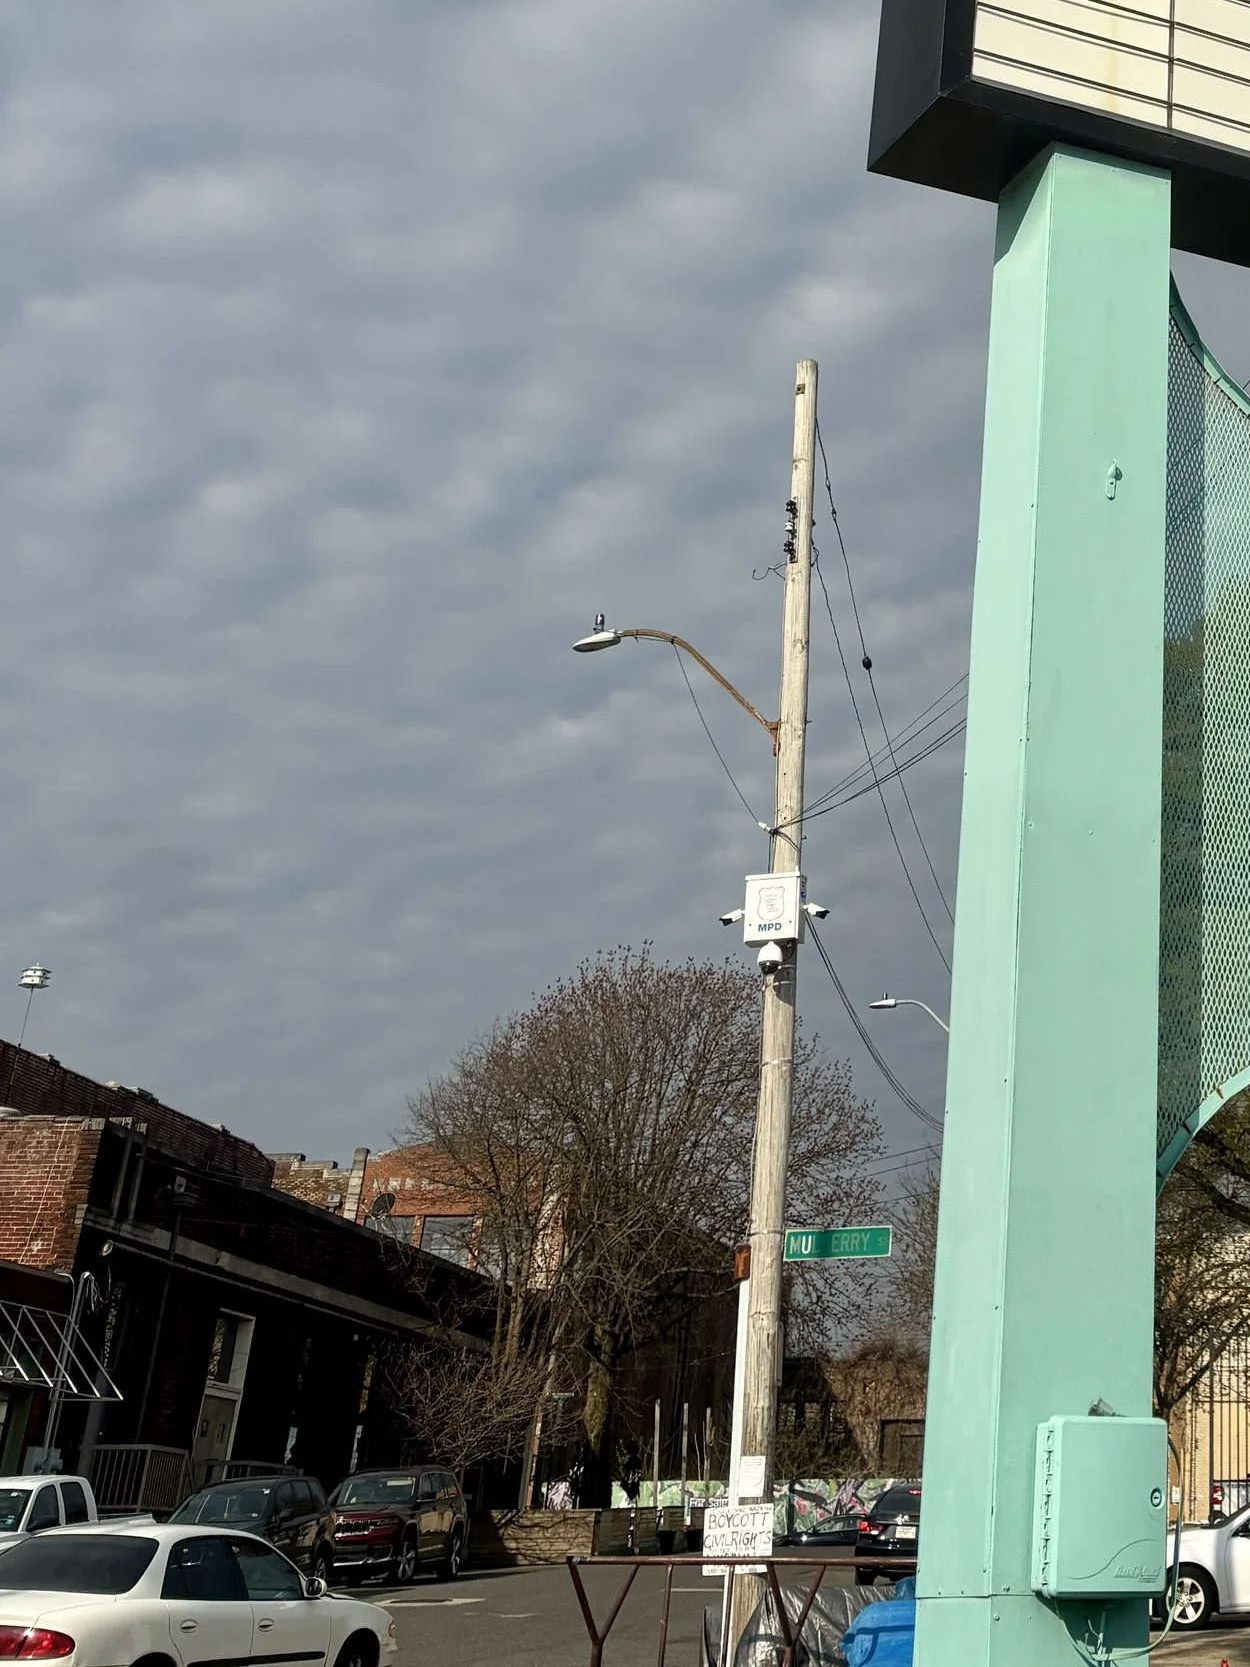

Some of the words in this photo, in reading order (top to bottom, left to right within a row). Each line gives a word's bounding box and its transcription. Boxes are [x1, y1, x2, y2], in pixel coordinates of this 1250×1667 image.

[758, 922, 782, 932] MPD
[789, 1232, 870, 1254] MULERRY
[708, 1511, 769, 1530] BOYCOTT
